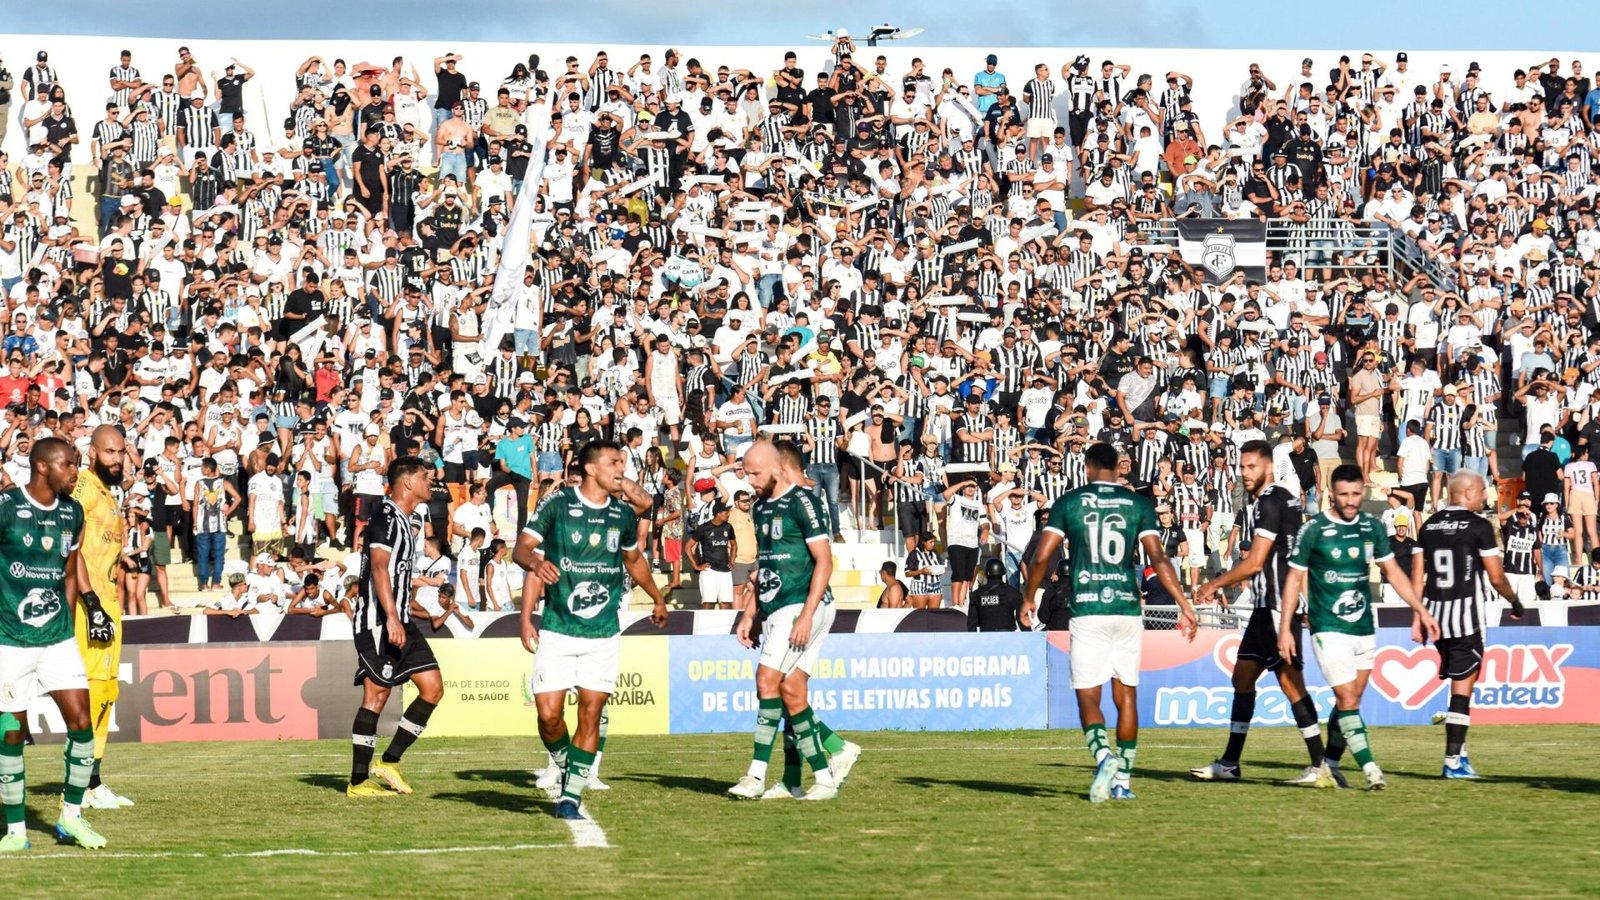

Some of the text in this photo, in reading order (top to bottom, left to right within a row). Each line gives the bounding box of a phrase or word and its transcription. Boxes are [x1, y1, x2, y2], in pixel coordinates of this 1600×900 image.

[1573, 469, 1587, 485] 13
[1083, 511, 1127, 565] 16
[25, 571, 51, 580] Novos
[1433, 549, 1455, 589] 9
[688, 659, 754, 681] OPERA
[850, 656, 914, 679] MAIOR
[919, 655, 1031, 678] PROGRAMA
[461, 680, 472, 688] DE
[475, 680, 510, 688] ESTADO
[461, 692, 510, 701] DA SAÚDE
[703, 692, 727, 712] DE
[842, 687, 930, 710] ELETIVAS
[935, 688, 964, 709] NO
[968, 684, 1013, 708] PAÍS
